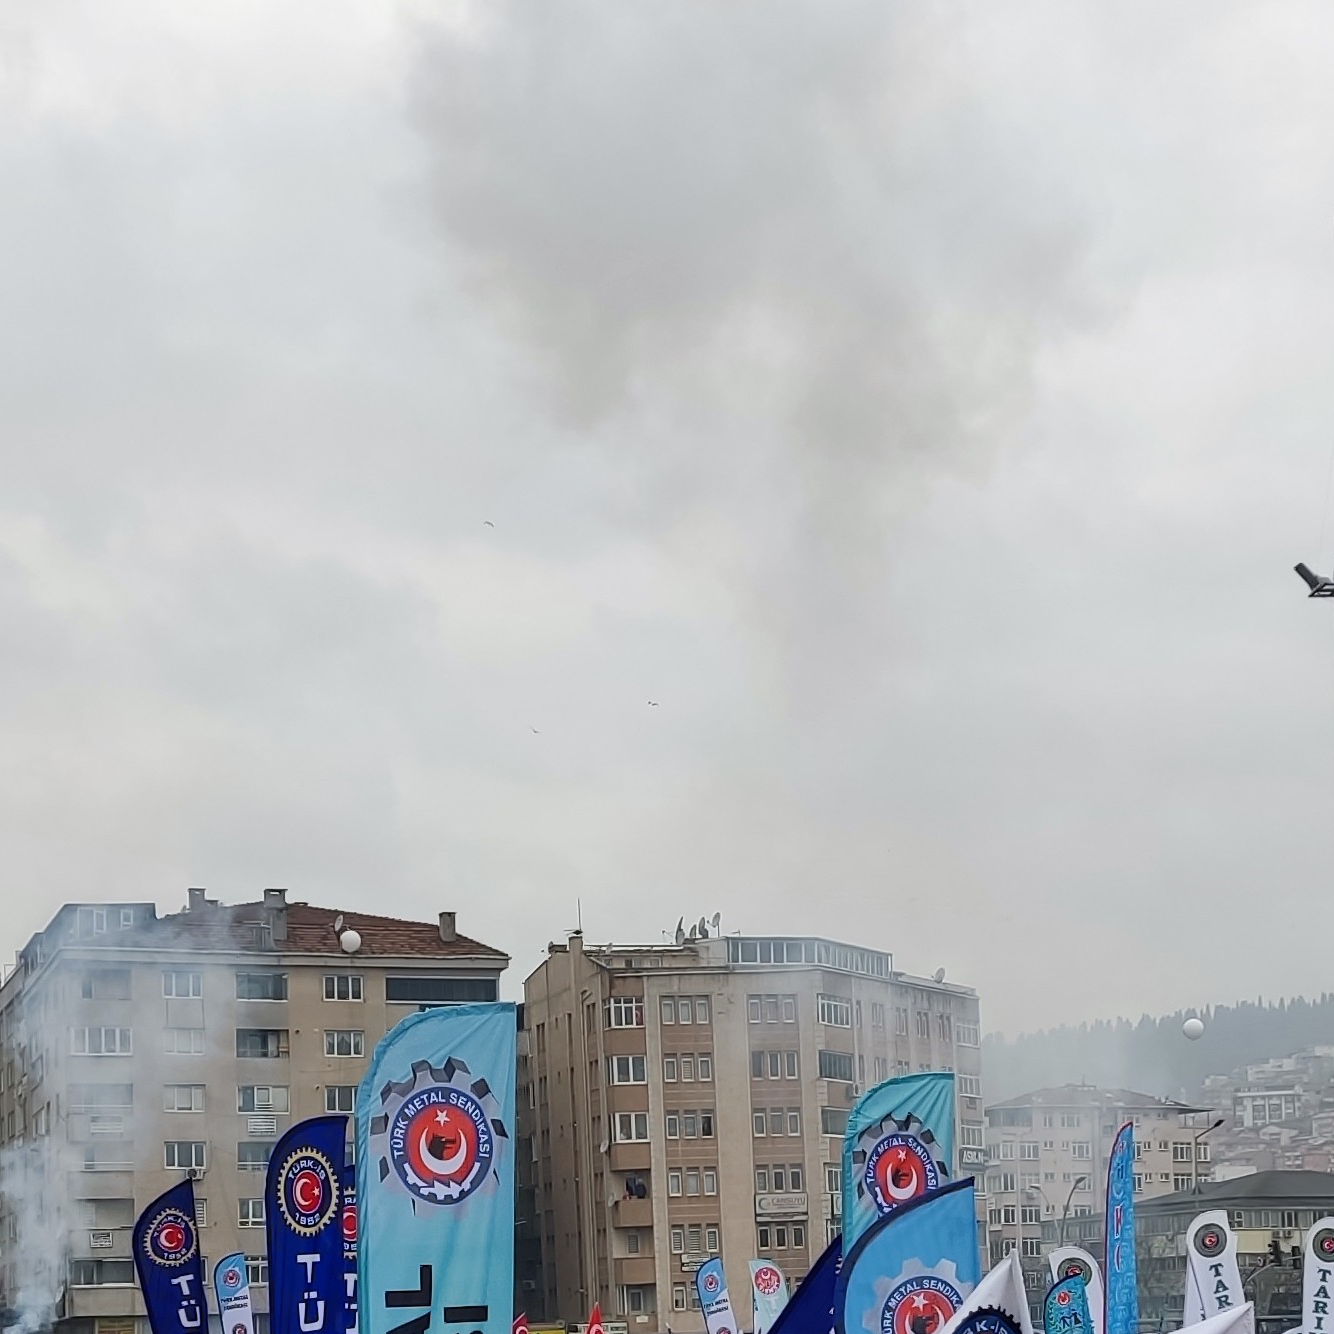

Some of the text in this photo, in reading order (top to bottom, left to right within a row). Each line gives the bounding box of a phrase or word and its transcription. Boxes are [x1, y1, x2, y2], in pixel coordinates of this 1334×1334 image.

[393, 1092, 490, 1159] TÜRK METAL SENDİKASI
[890, 1280, 922, 1309] METAL
